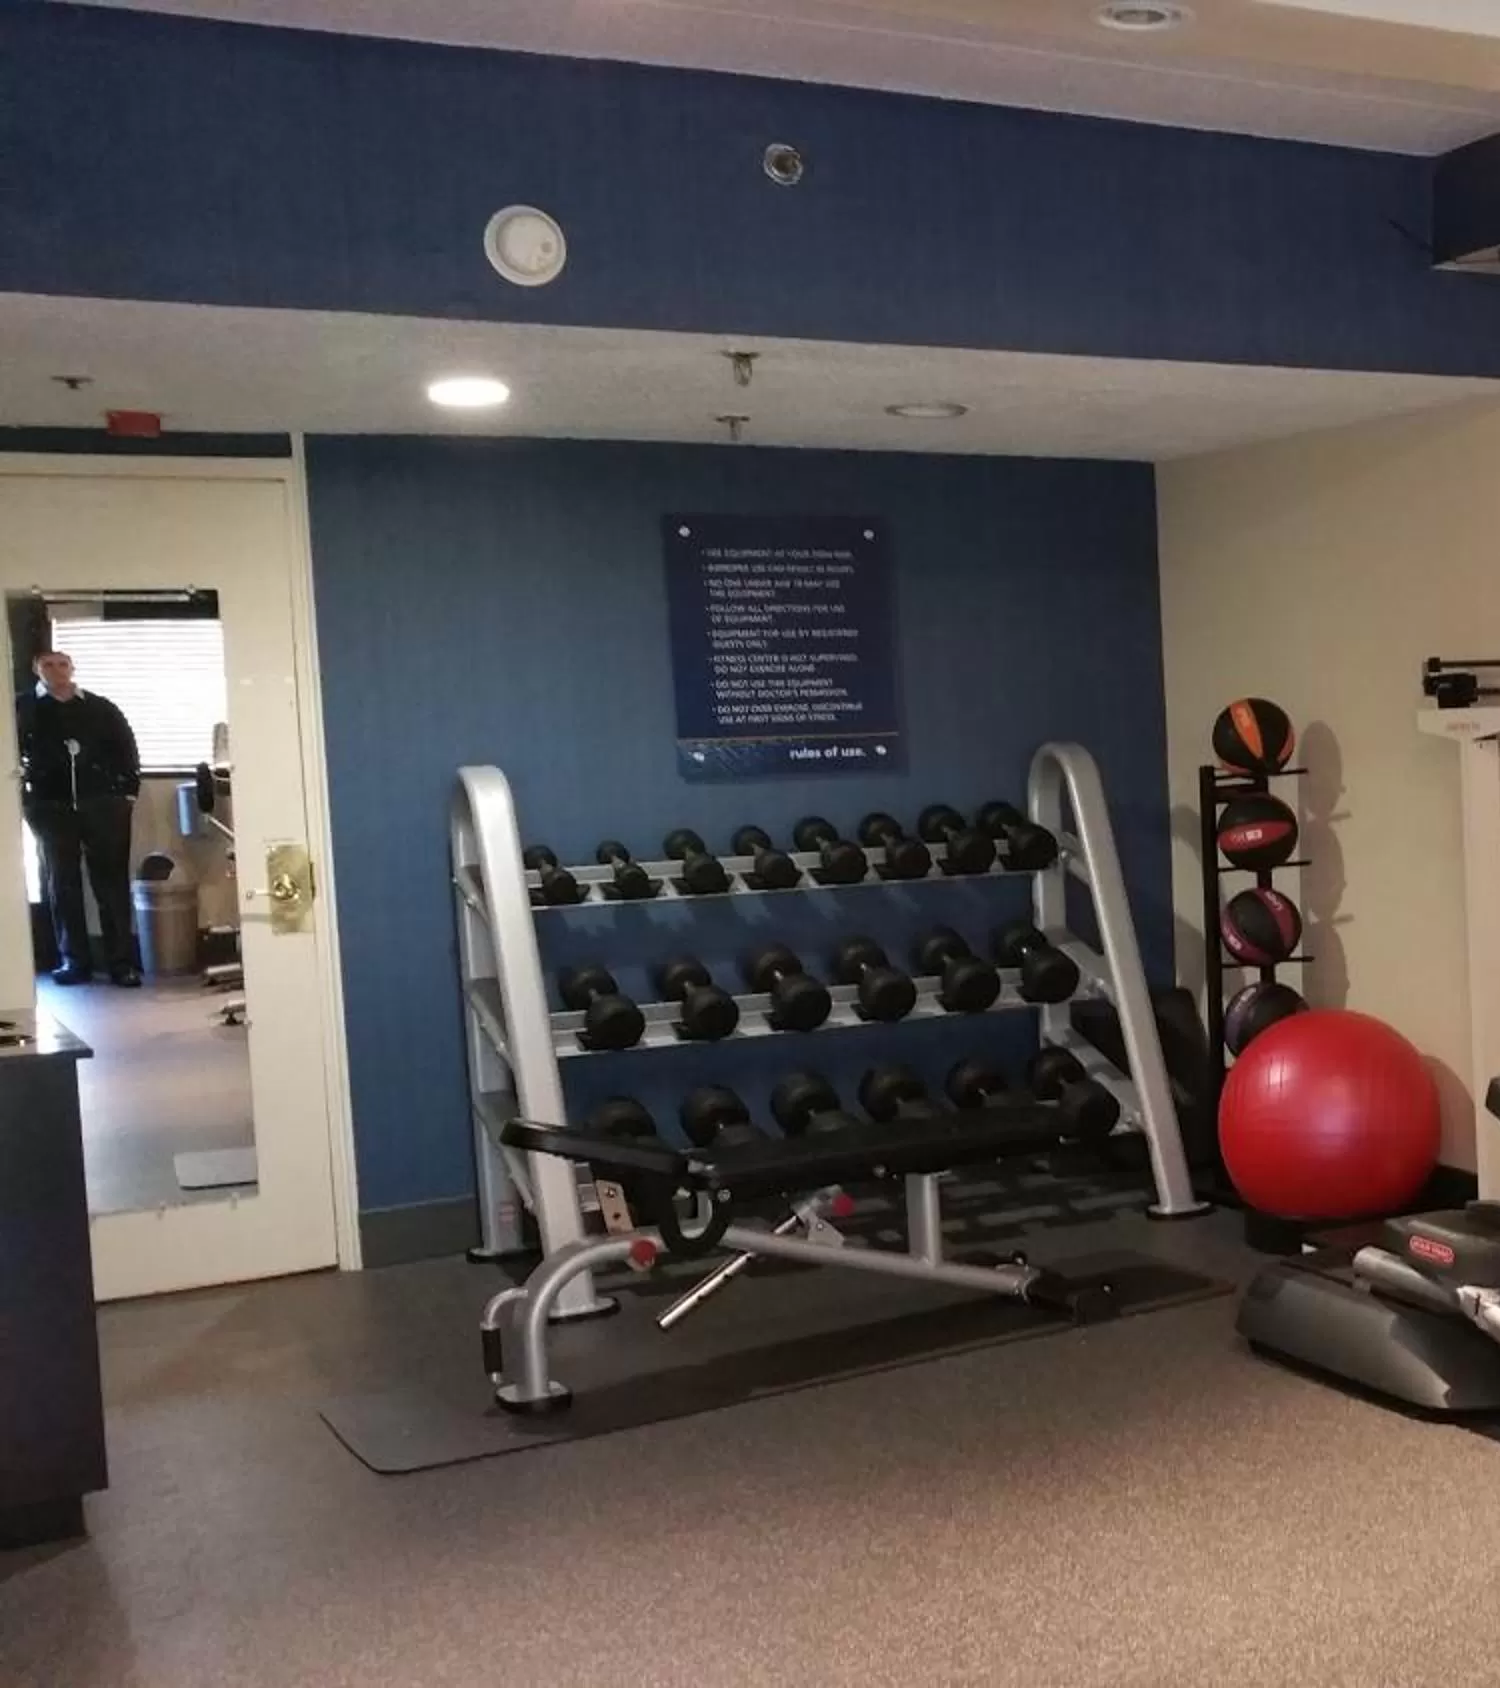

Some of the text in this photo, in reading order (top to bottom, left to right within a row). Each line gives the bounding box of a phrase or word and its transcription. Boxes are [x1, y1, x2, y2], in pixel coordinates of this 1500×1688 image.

[790, 746, 866, 760] rules of use.
